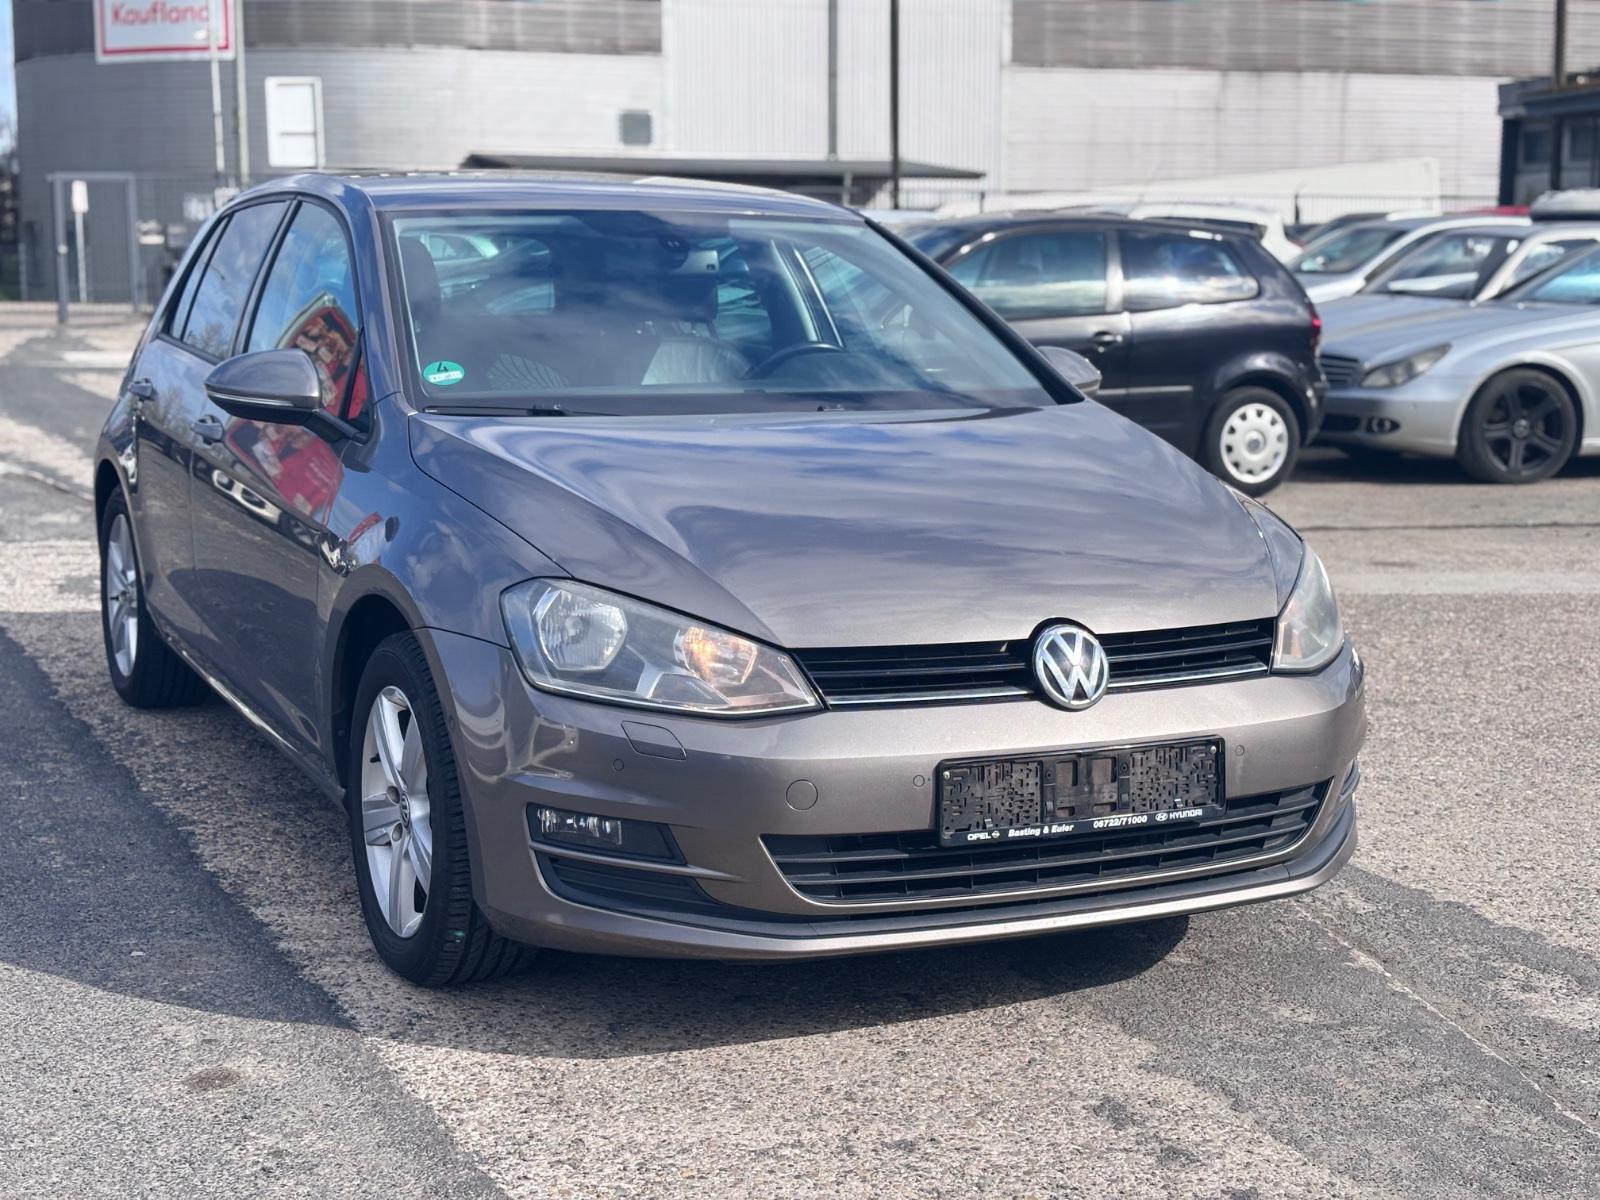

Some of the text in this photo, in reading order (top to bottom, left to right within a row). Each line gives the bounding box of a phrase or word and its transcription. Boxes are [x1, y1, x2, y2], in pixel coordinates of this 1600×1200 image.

[436, 361, 449, 373] 4
[967, 808, 1203, 841] OPEL Basting & Euler 06722/71000 HYUNDAI
